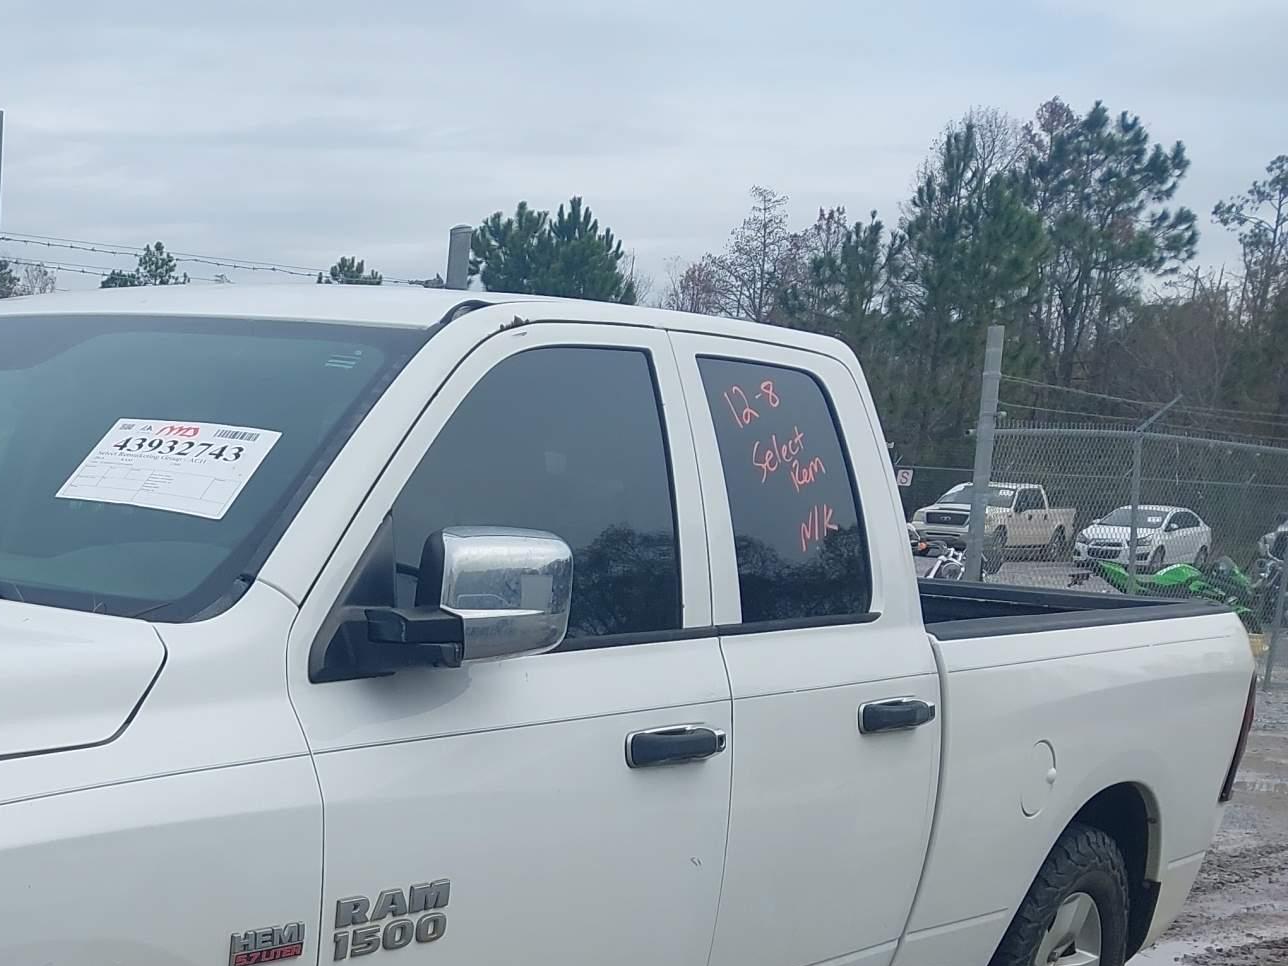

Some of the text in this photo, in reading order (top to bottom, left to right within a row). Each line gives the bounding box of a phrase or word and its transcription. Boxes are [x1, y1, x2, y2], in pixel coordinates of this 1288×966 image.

[724, 380, 780, 429] 12-8
[112, 436, 245, 463] 43932743
[752, 425, 804, 484] Select
[790, 456, 826, 493] Rem
[899, 470, 910, 485] S
[335, 878, 451, 929] RAM
[230, 921, 306, 953] HEMI
[261, 943, 302, 961] LITER
[332, 912, 448, 962] 1500
